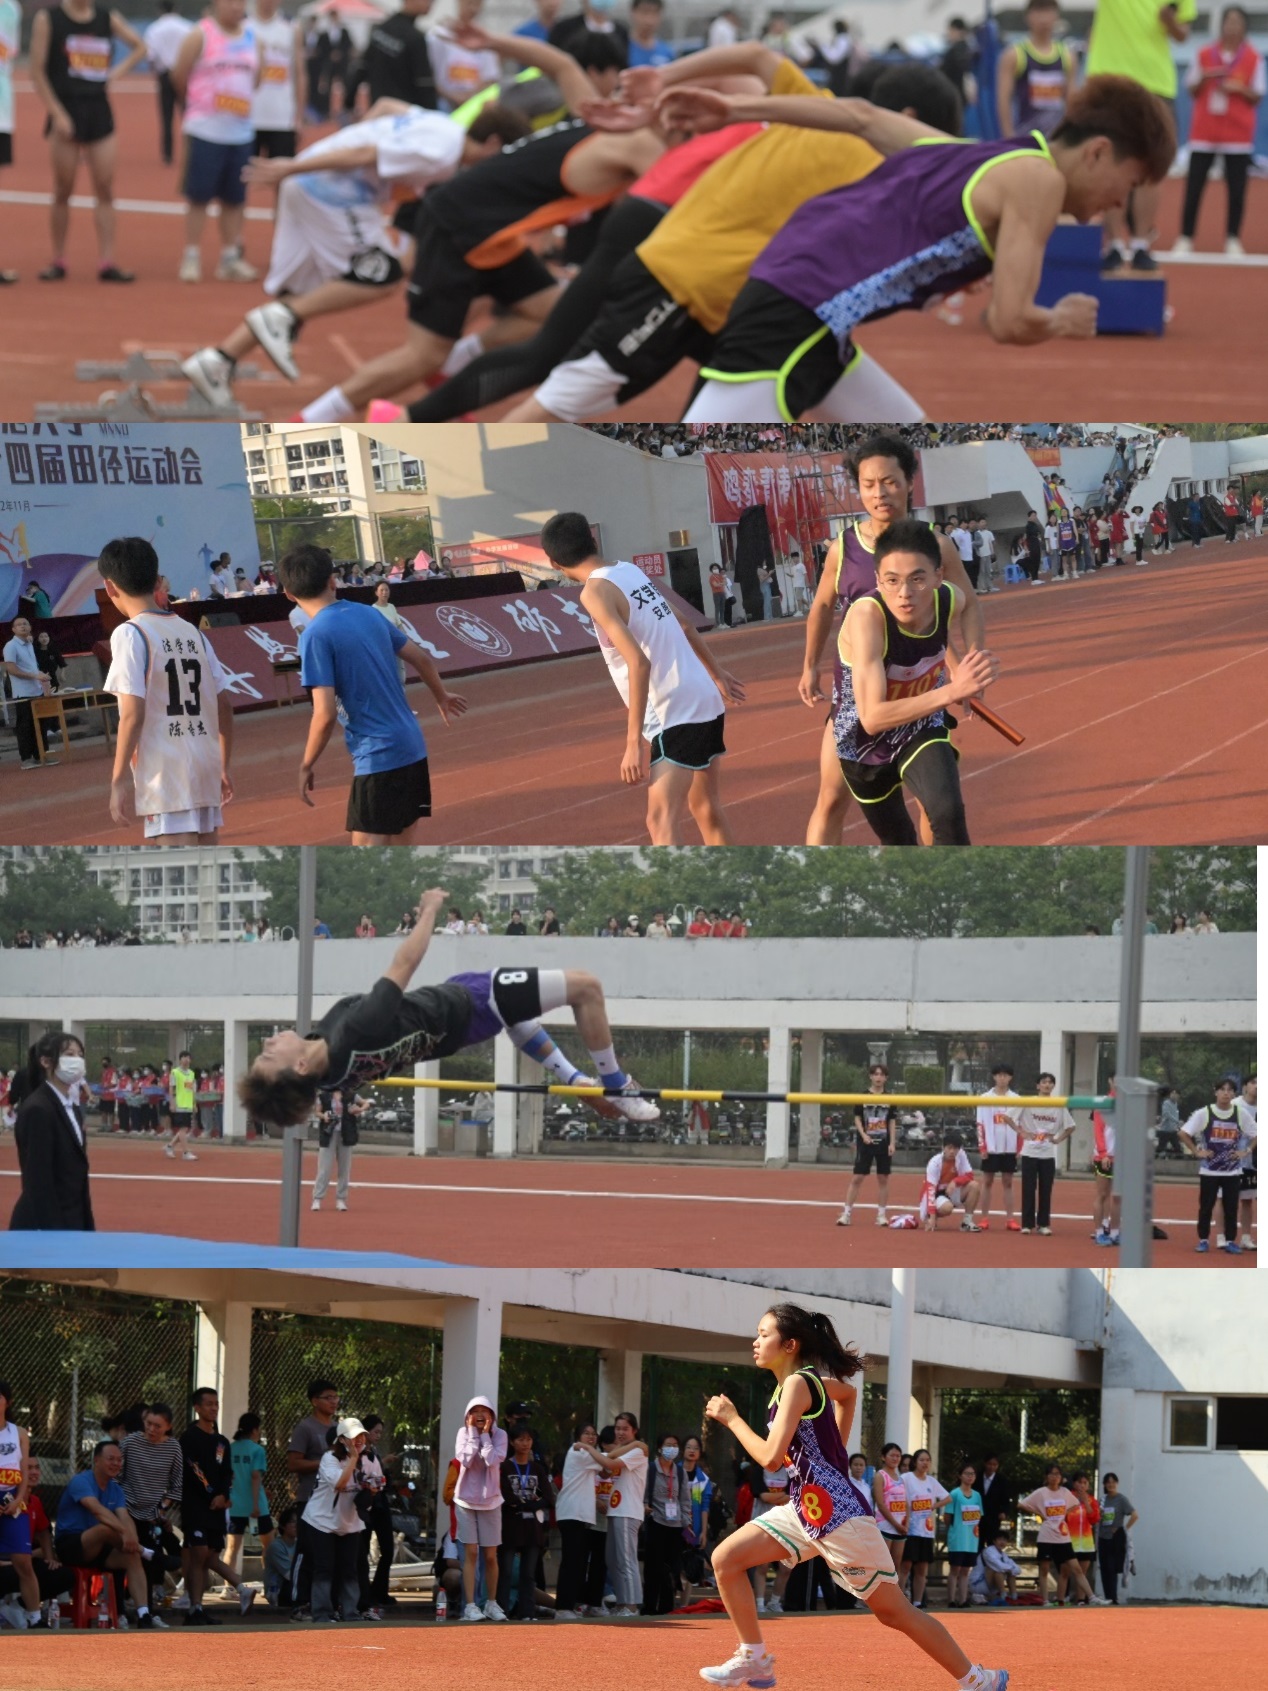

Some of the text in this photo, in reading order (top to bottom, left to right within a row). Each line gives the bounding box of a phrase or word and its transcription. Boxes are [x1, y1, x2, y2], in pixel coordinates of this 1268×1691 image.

[0, 442, 203, 484] 四届田径运动会
[635, 554, 662, 566] 运动员
[165, 658, 201, 716] 13
[498, 970, 528, 985] 8
[803, 1492, 823, 1520] 8
[891, 1501, 906, 1512] 023
